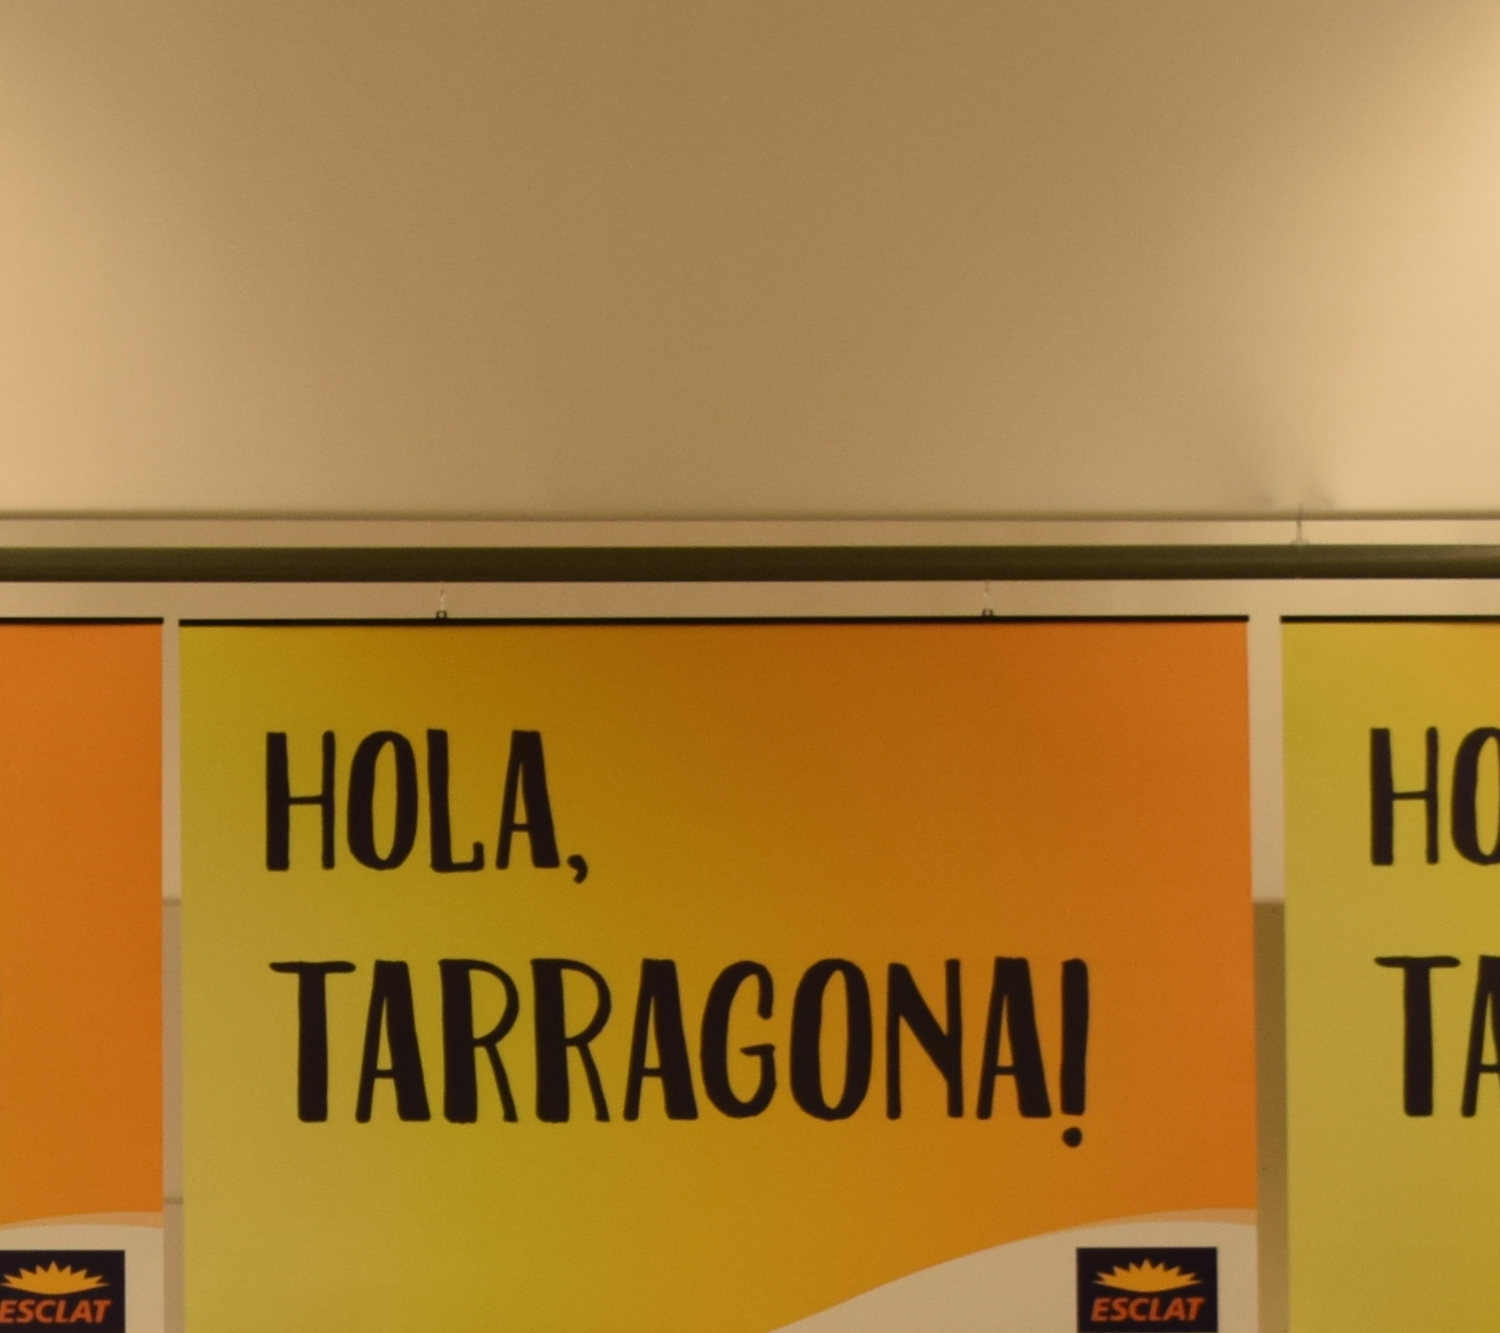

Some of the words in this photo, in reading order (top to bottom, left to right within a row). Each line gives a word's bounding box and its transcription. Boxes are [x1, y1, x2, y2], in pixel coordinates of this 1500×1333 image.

[265, 728, 589, 884] HOLA,
[269, 956, 1090, 1147] TARRAGONA!
[1090, 1295, 1204, 1323] ESCLAT
